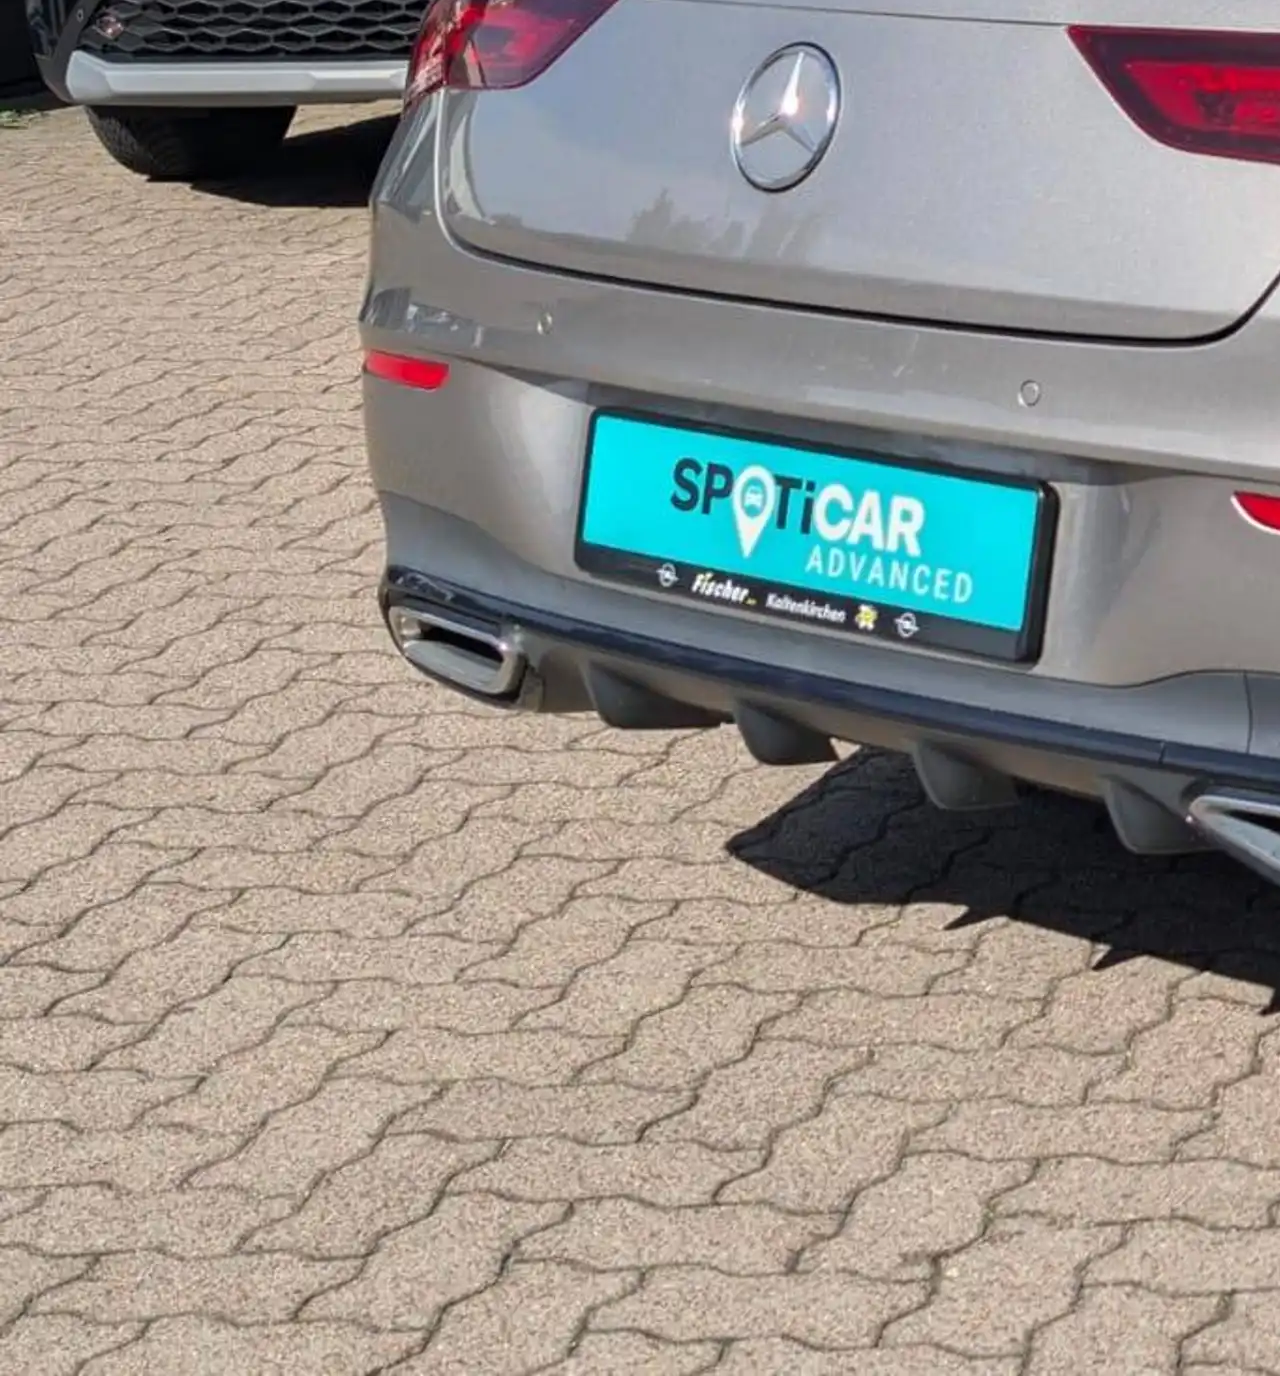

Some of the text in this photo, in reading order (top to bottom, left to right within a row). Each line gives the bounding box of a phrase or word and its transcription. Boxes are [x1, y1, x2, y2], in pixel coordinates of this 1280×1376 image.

[690, 572, 847, 623] Fischer Kaltenkirchen
[804, 543, 974, 604] ADVANCED
